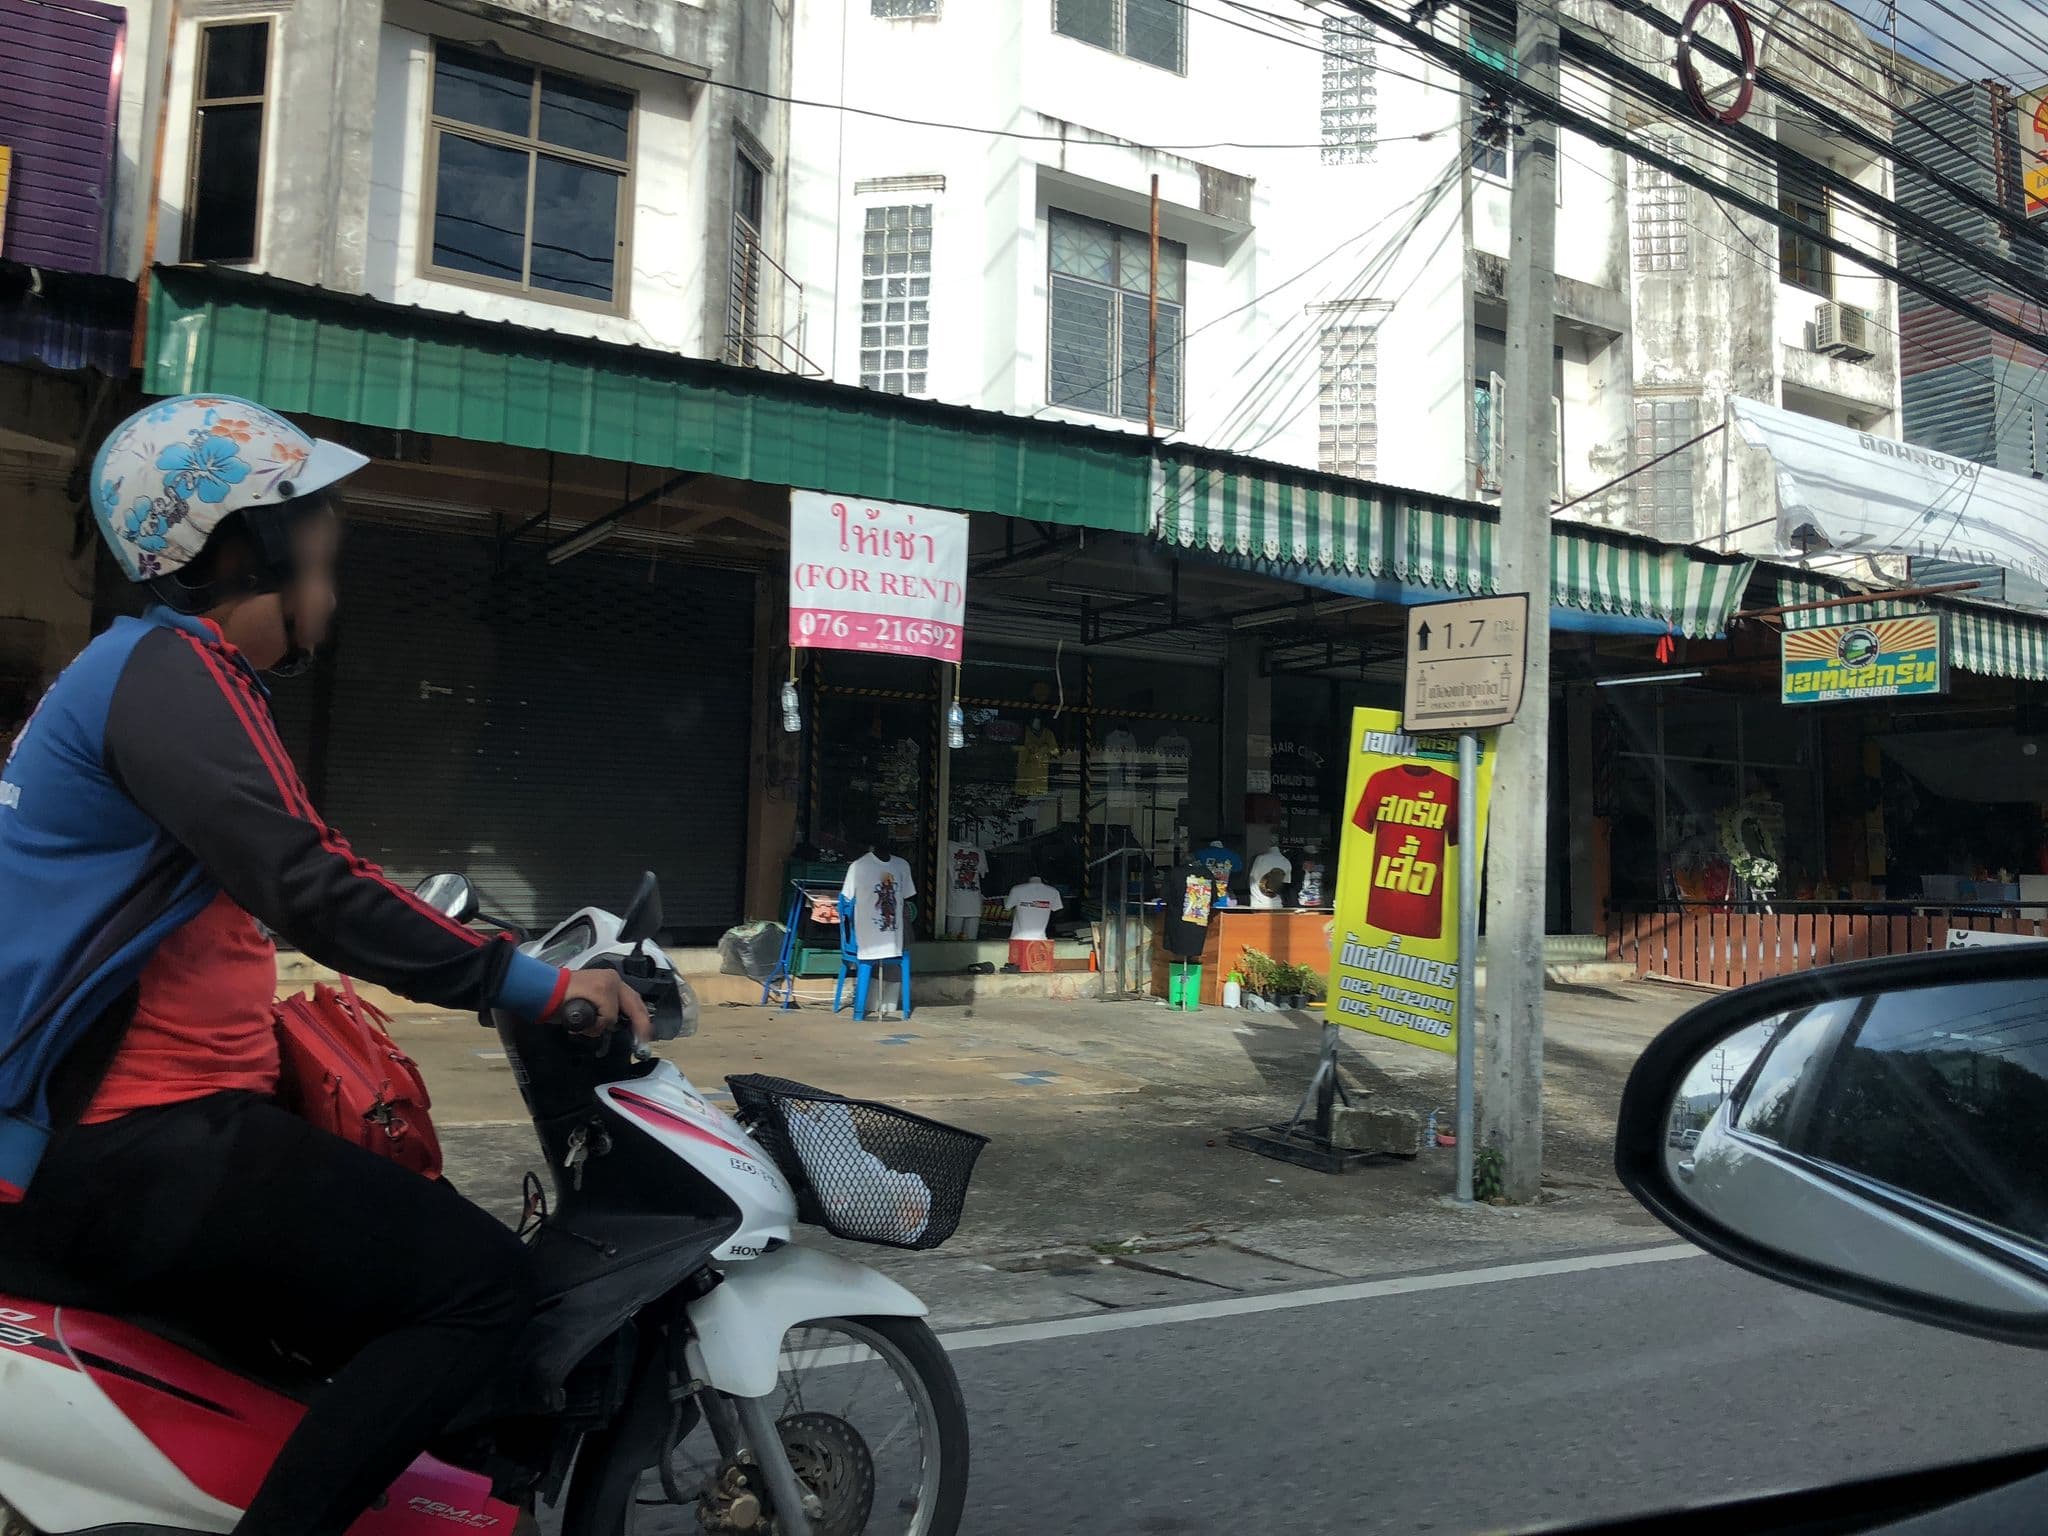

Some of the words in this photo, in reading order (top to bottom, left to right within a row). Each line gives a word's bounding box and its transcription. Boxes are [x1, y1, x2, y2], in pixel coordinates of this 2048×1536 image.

[831, 503, 935, 563] ให้เช่า
[794, 563, 871, 592] (FOR
[880, 572, 962, 608] RENT)
[799, 613, 849, 638] 076
[875, 619, 956, 649] 216592
[1443, 620, 1486, 649] 1.7
[1376, 791, 1448, 830] สกรีน
[1374, 835, 1438, 896] เสื้อ
[1340, 976, 1455, 1016] 082-4032044
[1338, 997, 1452, 1038] 095-4164886
[408, 1496, 499, 1526] PGM-FI
